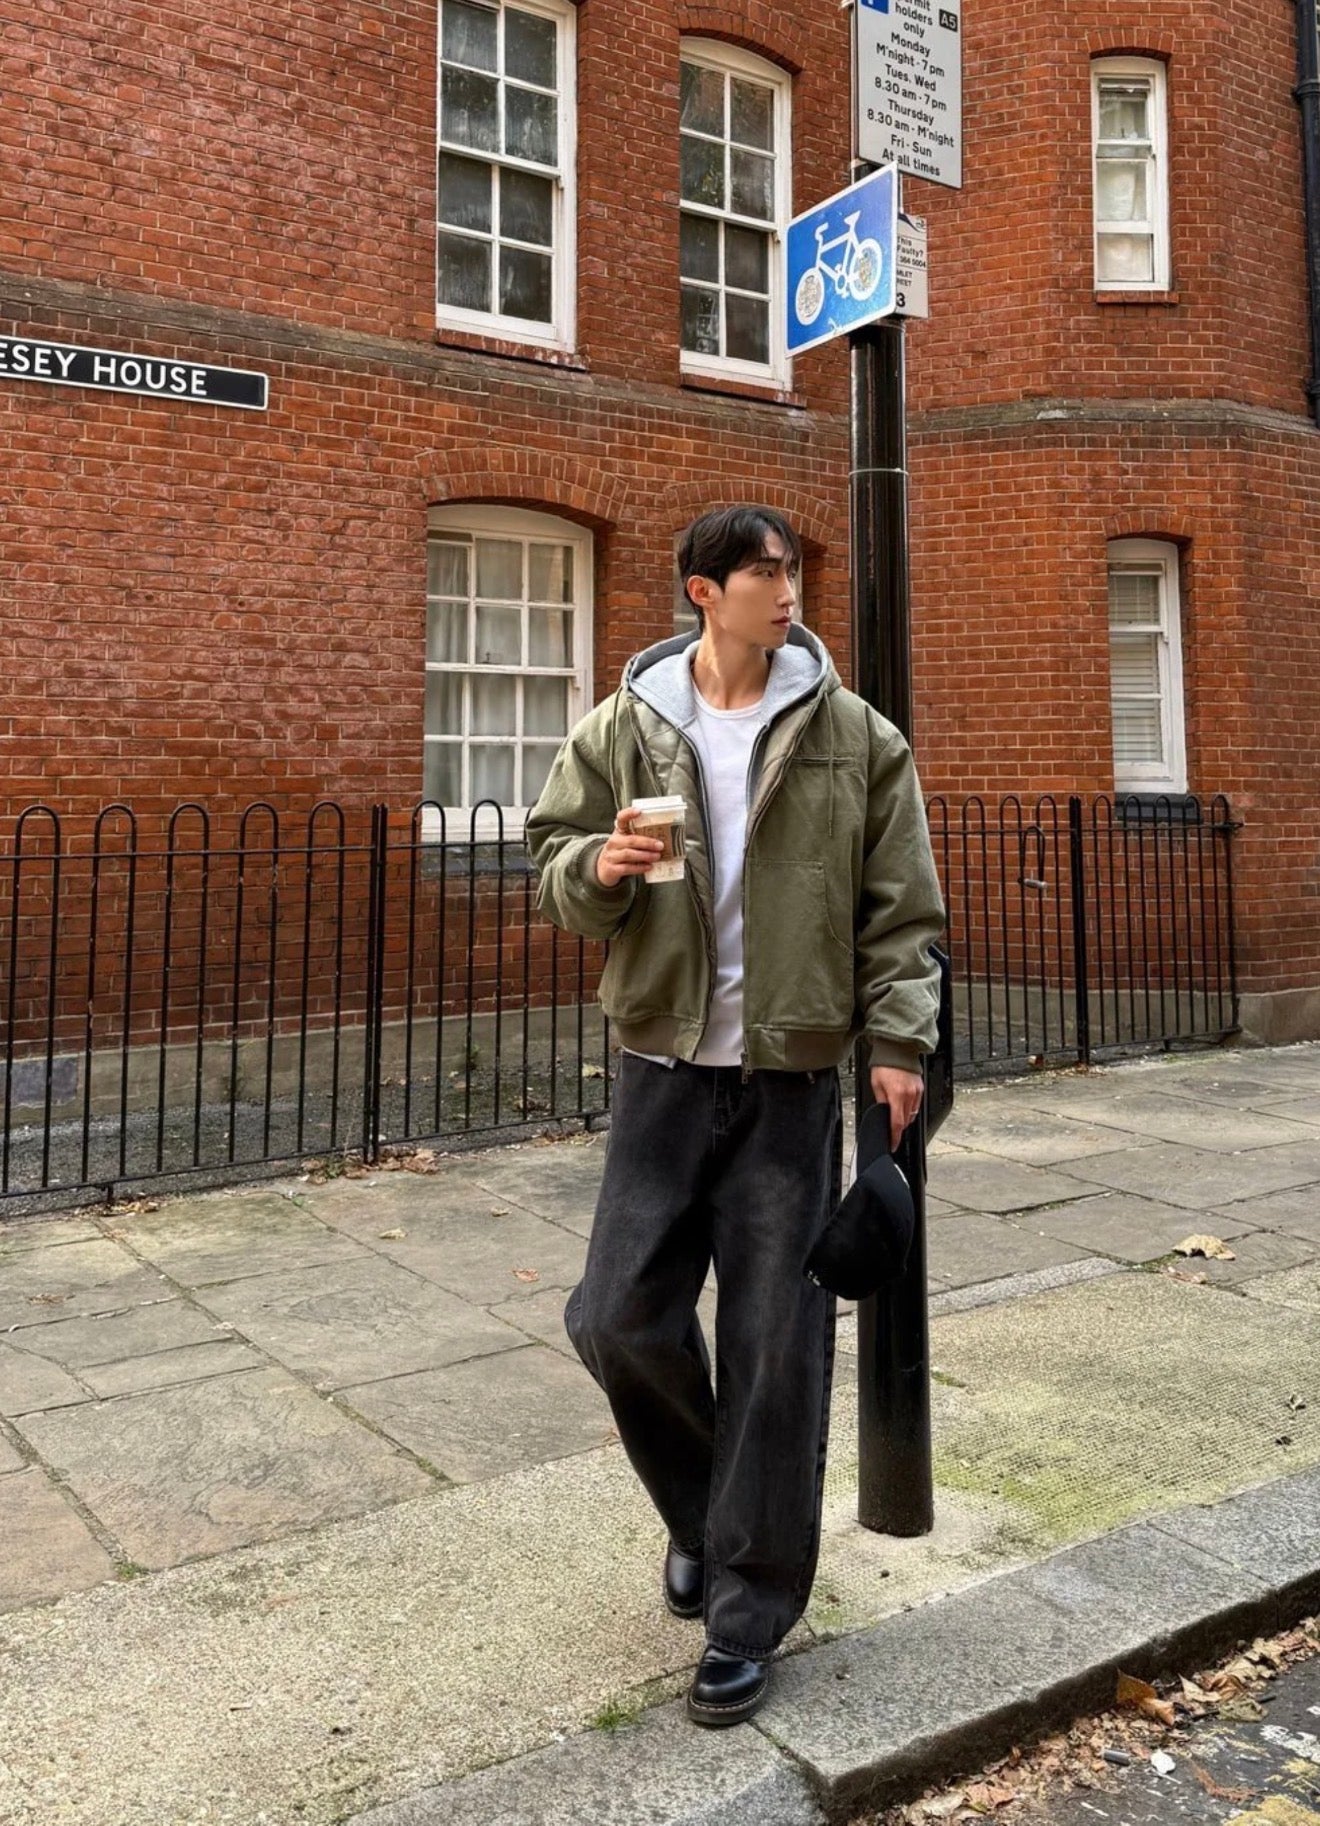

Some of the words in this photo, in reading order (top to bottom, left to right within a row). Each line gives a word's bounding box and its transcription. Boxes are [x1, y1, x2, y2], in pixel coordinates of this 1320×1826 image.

[895, 2, 933, 25] holders
[941, 13, 957, 30] A5
[903, 22, 925, 38] only
[891, 32, 930, 57] Monday
[876, 43, 915, 66] M'night
[929, 65, 945, 77] pm
[874, 76, 900, 94] 8.30
[901, 88, 917, 100] am
[931, 99, 947, 111] pm
[914, 74, 936, 91] Wed
[887, 98, 934, 126] Thursday
[867, 108, 892, 126] 8.30
[894, 120, 910, 132] am
[917, 125, 954, 148] M'night
[890, 134, 905, 148] Fri
[912, 141, 932, 157] Sun
[882, 148, 894, 161] At
[897, 154, 910, 167] all
[913, 158, 940, 176] times
[93, 355, 208, 396] HOUSE
